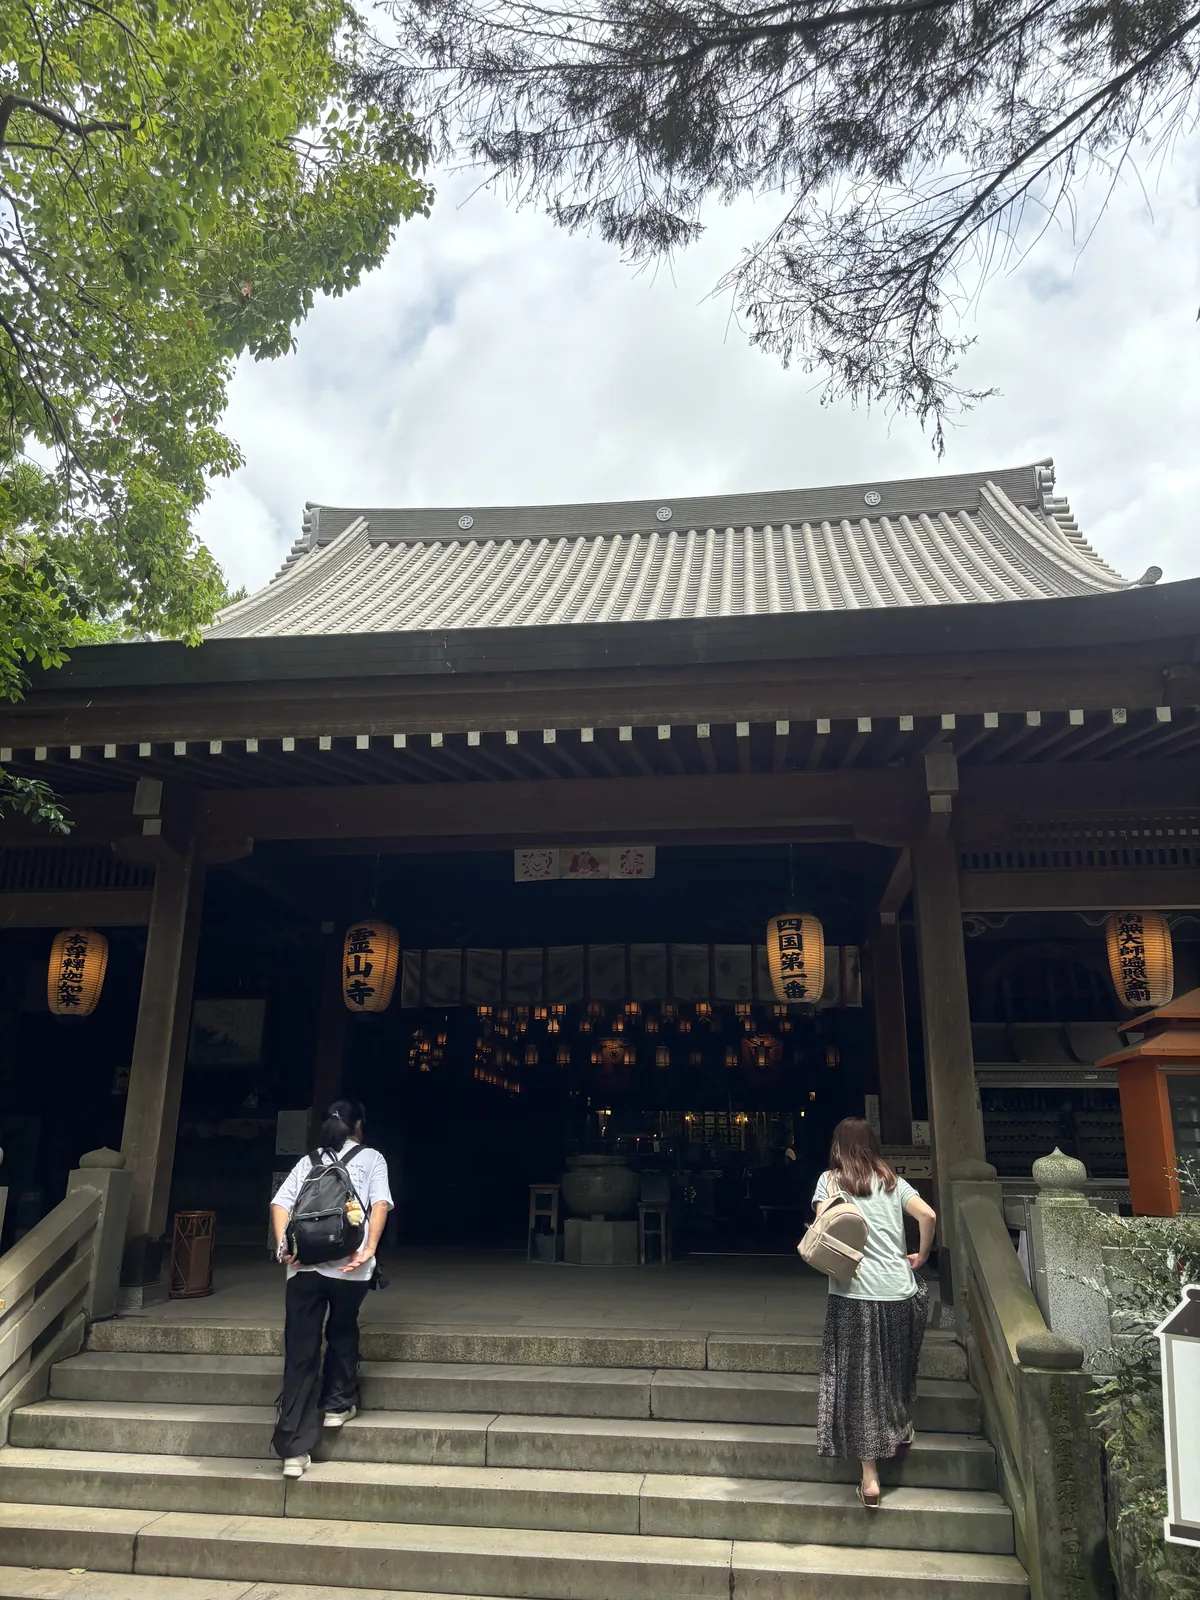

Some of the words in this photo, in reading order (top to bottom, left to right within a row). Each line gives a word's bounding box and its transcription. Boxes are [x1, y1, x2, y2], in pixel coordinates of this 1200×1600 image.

[345, 927, 377, 1006] 霊山寺
[776, 918, 810, 999] 四国第一番
[1118, 913, 1151, 1002] 南無大師遍照金剛
